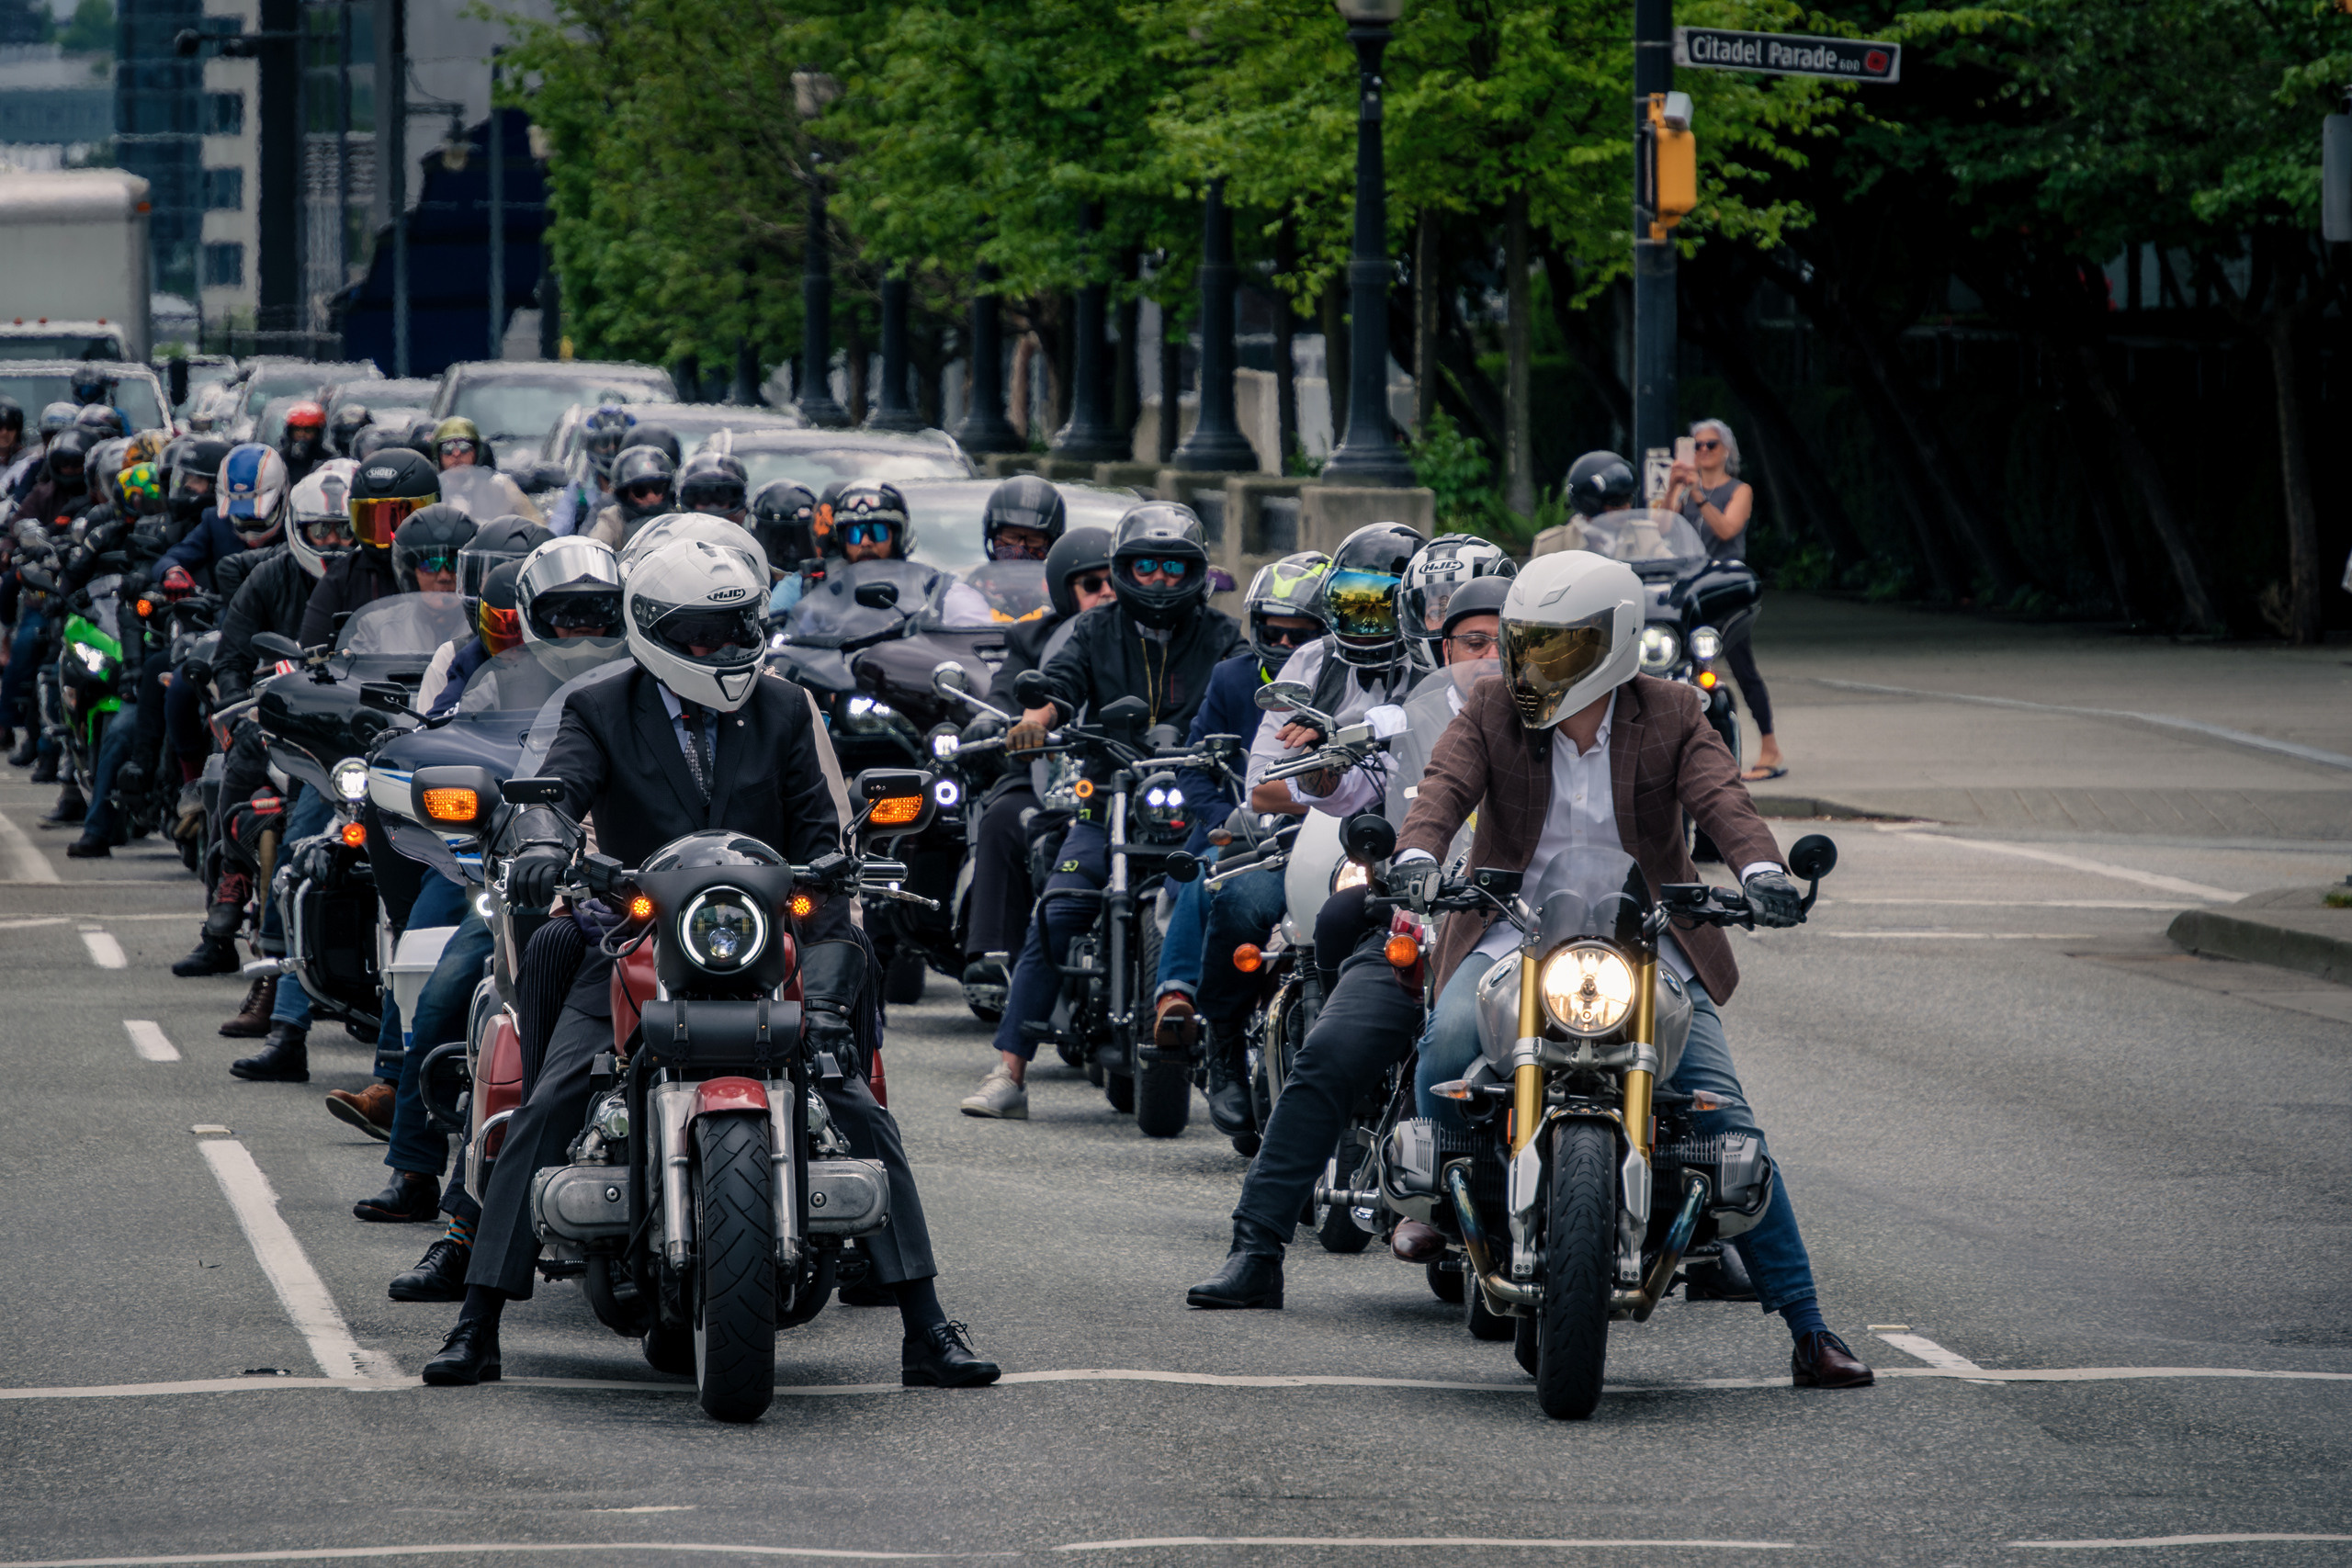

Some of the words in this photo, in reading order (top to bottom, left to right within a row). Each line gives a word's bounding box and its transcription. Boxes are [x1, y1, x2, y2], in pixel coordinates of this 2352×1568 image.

[1691, 35, 1762, 63] Citadel
[1768, 41, 1838, 70] Parade
[1839, 58, 1860, 72] 600
[369, 468, 393, 477] SHOEI
[1424, 560, 1458, 572] HJC
[713, 588, 742, 600] HJC
